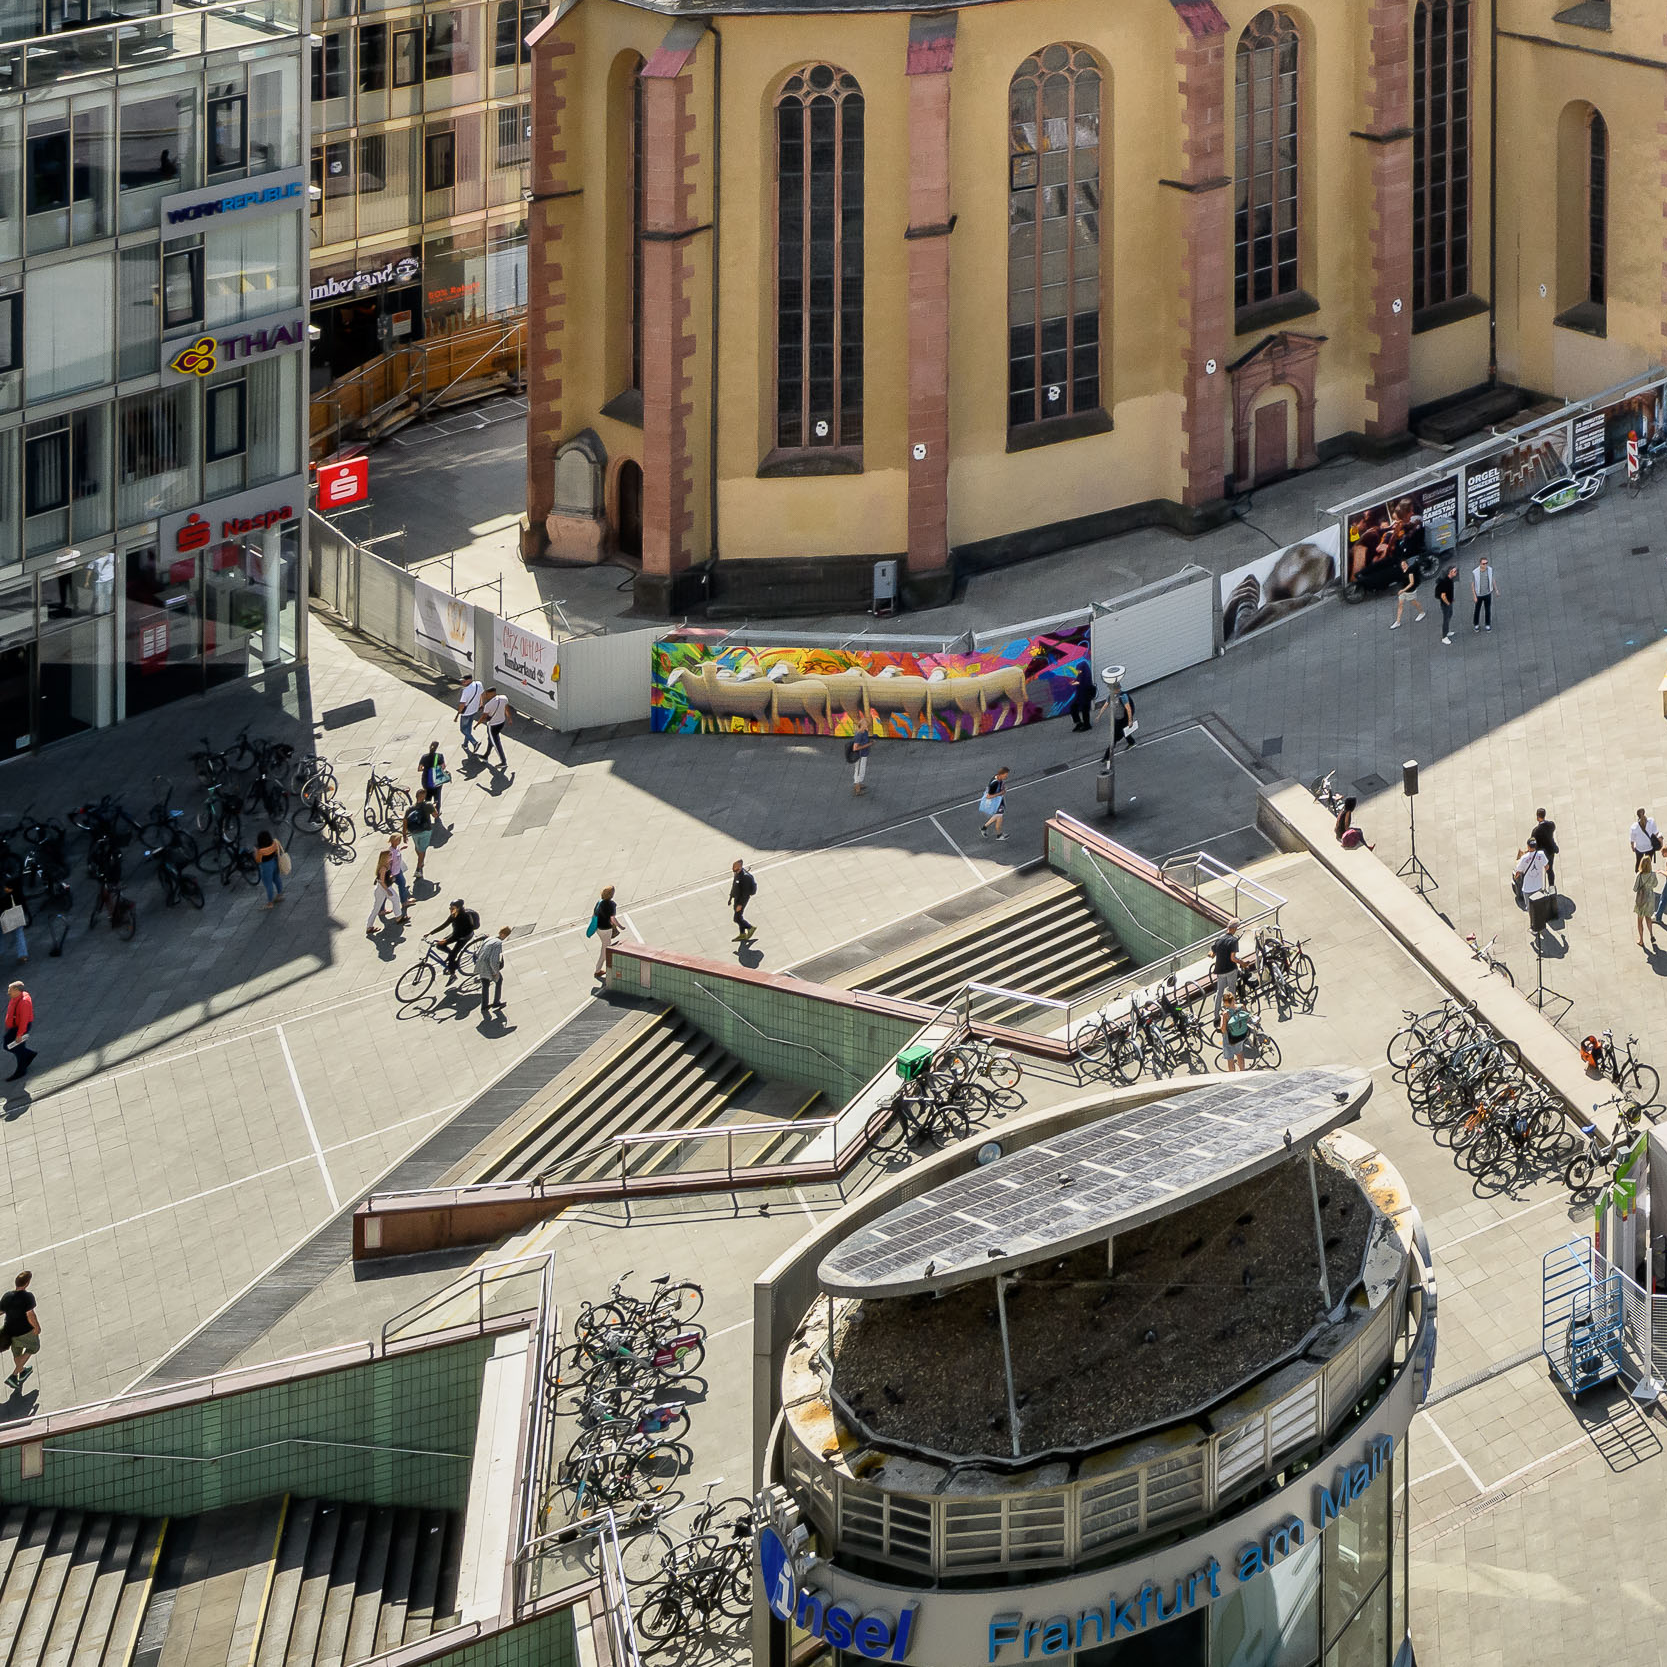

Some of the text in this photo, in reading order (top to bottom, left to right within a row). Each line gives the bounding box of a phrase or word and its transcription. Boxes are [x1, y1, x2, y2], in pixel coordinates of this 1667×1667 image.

[222, 320, 303, 361] THAI
[1467, 467, 1501, 486] ORGEL
[221, 505, 293, 539] Naspa
[1422, 503, 1456, 521] SAMSTAG
[503, 651, 536, 681] Timberland
[988, 1434, 1393, 1663] Frankfurt am Main
